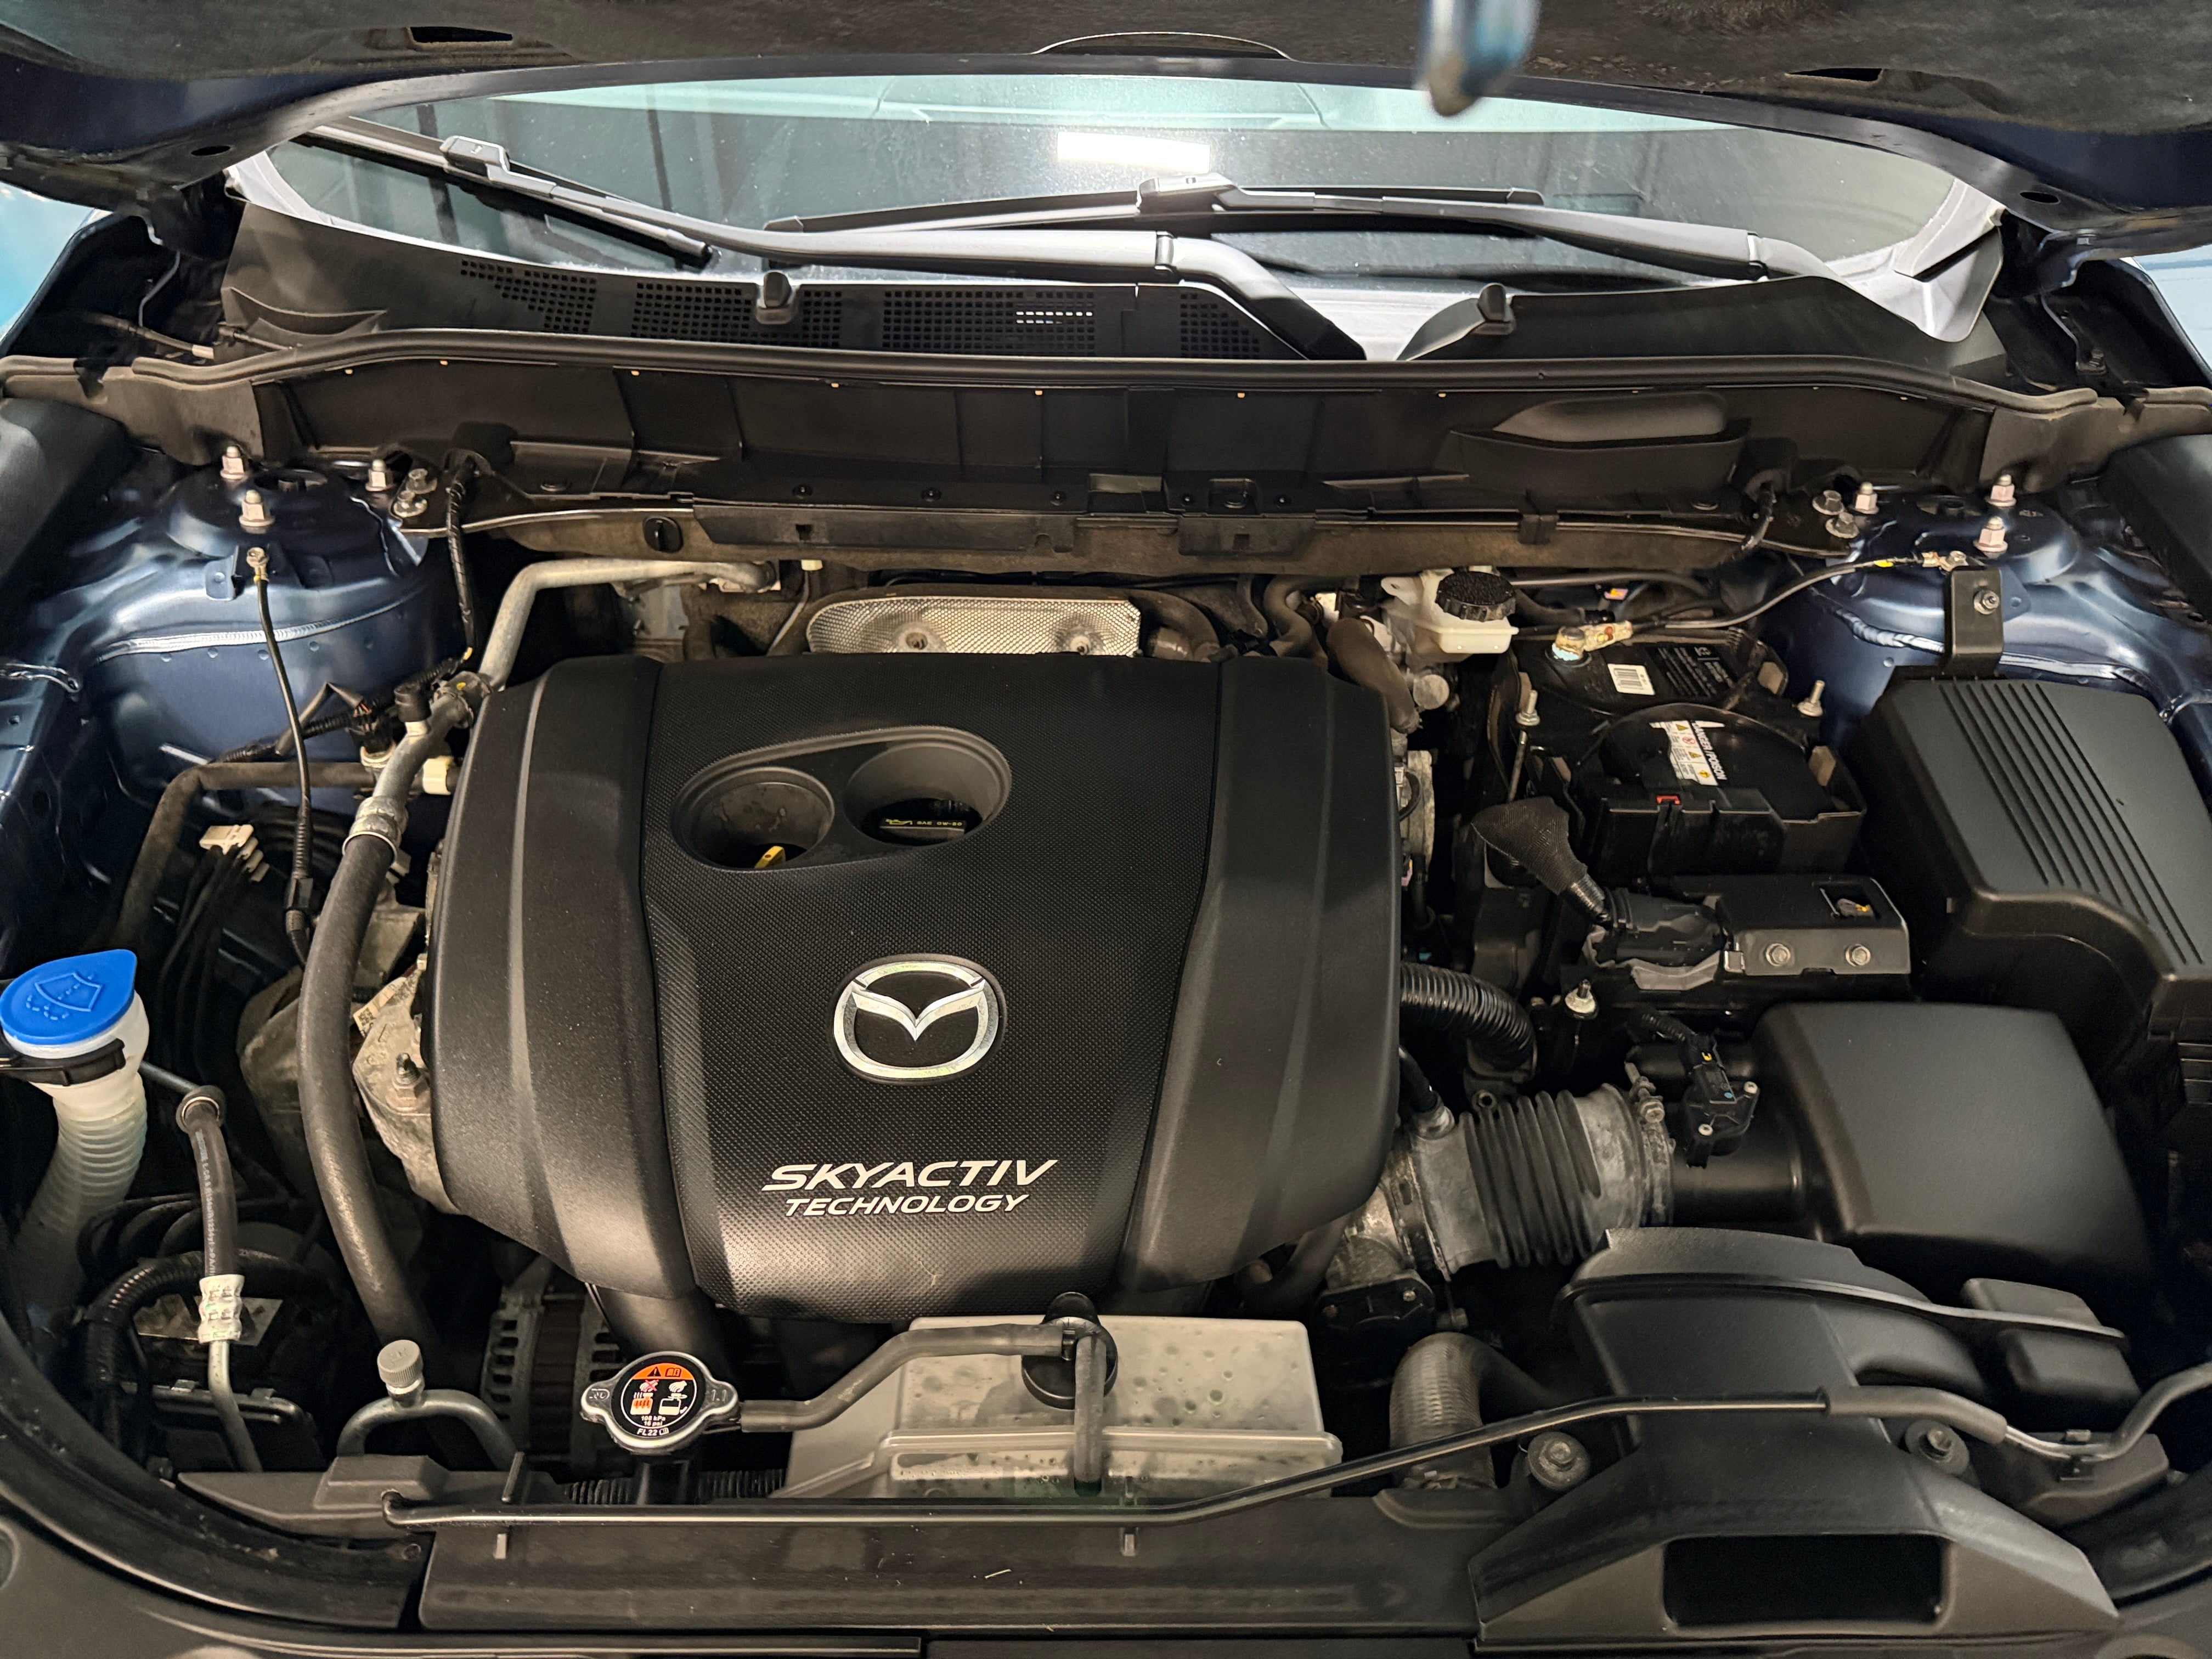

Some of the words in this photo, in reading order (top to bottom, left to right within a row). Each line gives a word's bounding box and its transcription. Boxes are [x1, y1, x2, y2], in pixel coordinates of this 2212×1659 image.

[761, 1159, 1058, 1191] SKYACTIV
[785, 1194, 1030, 1216] TECHNOLOGY
[636, 1427, 658, 1436] FL22
